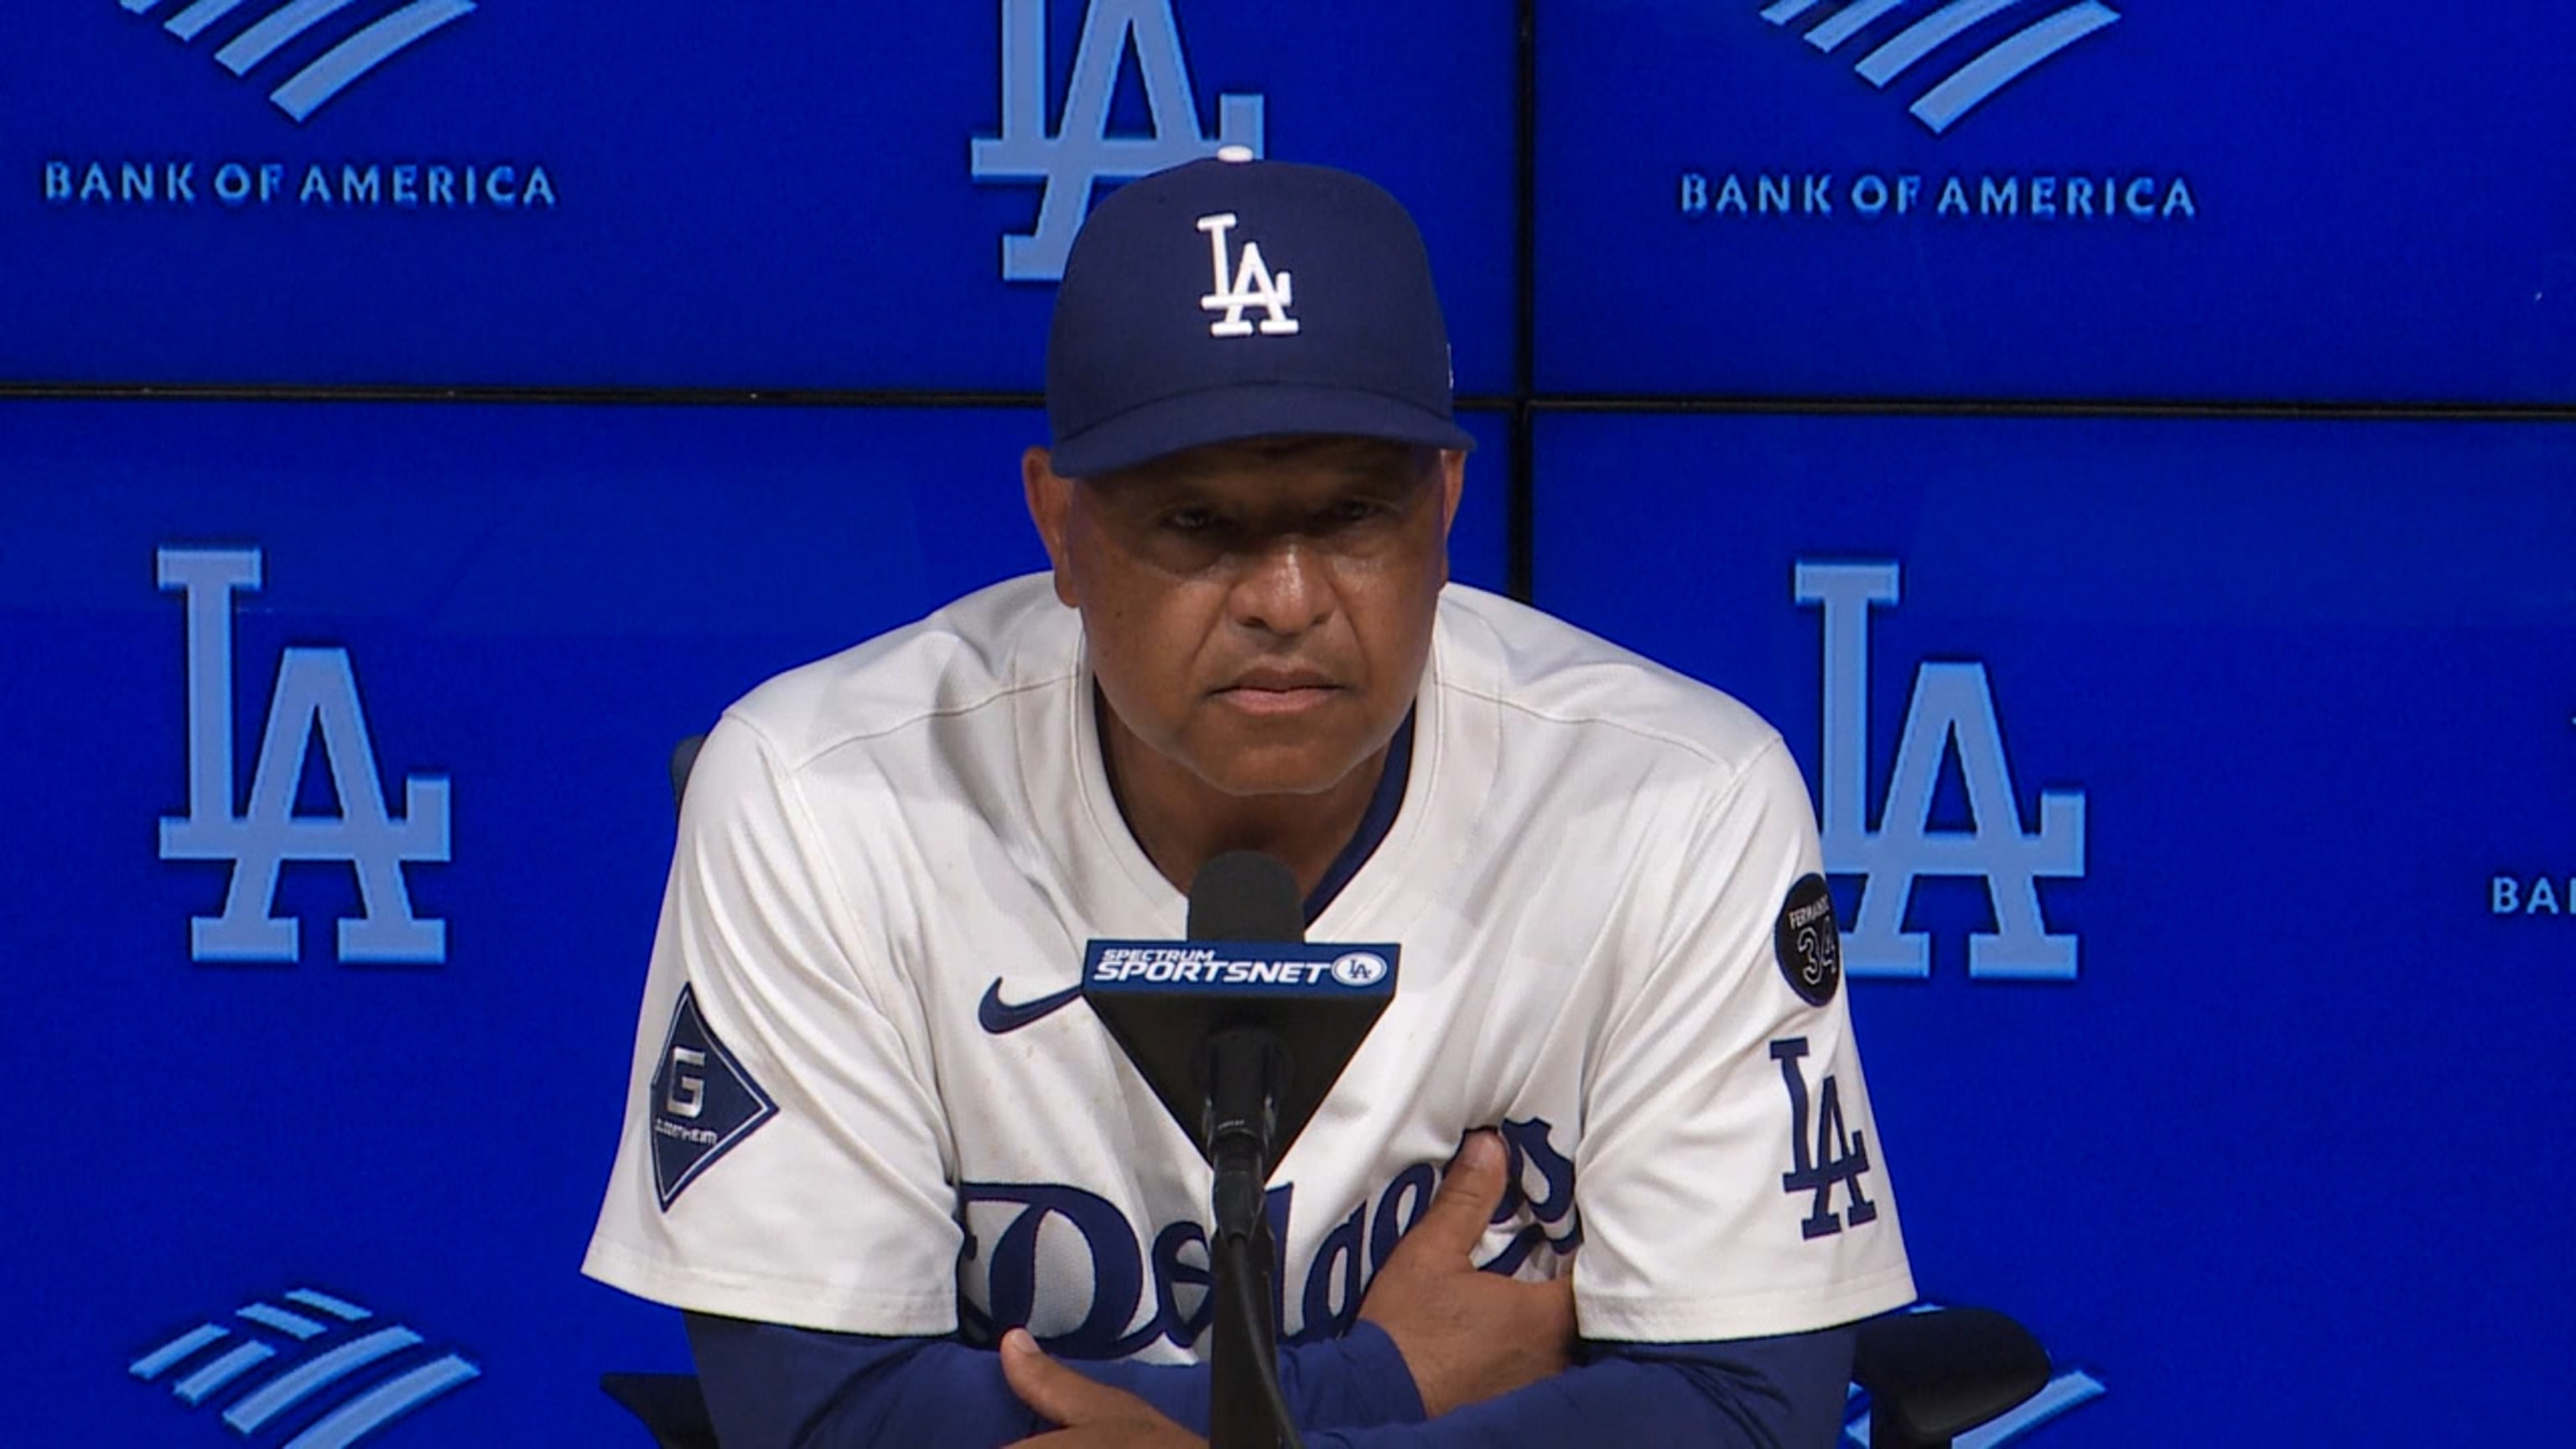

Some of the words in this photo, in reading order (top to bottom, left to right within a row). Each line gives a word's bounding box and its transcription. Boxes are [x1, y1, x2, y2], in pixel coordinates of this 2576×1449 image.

[44, 162, 195, 200] BANK
[215, 163, 283, 201] OF
[299, 164, 556, 205] AMERICA
[1681, 174, 1832, 213] BANK
[1852, 175, 1921, 216] OF
[1937, 176, 2195, 217] AMERICA
[1197, 213, 1299, 336] LA
[157, 548, 450, 963] LA
[1794, 562, 2085, 979] LA
[2493, 876, 2576, 915] BA
[1093, 960, 1332, 984] SPORTSNET
[1349, 959, 1372, 979] LA
[1101, 948, 1216, 963] SPECTRUM
[1797, 915, 1836, 985] 34
[667, 1046, 706, 1119] G
[1770, 1036, 1877, 1240] LA
